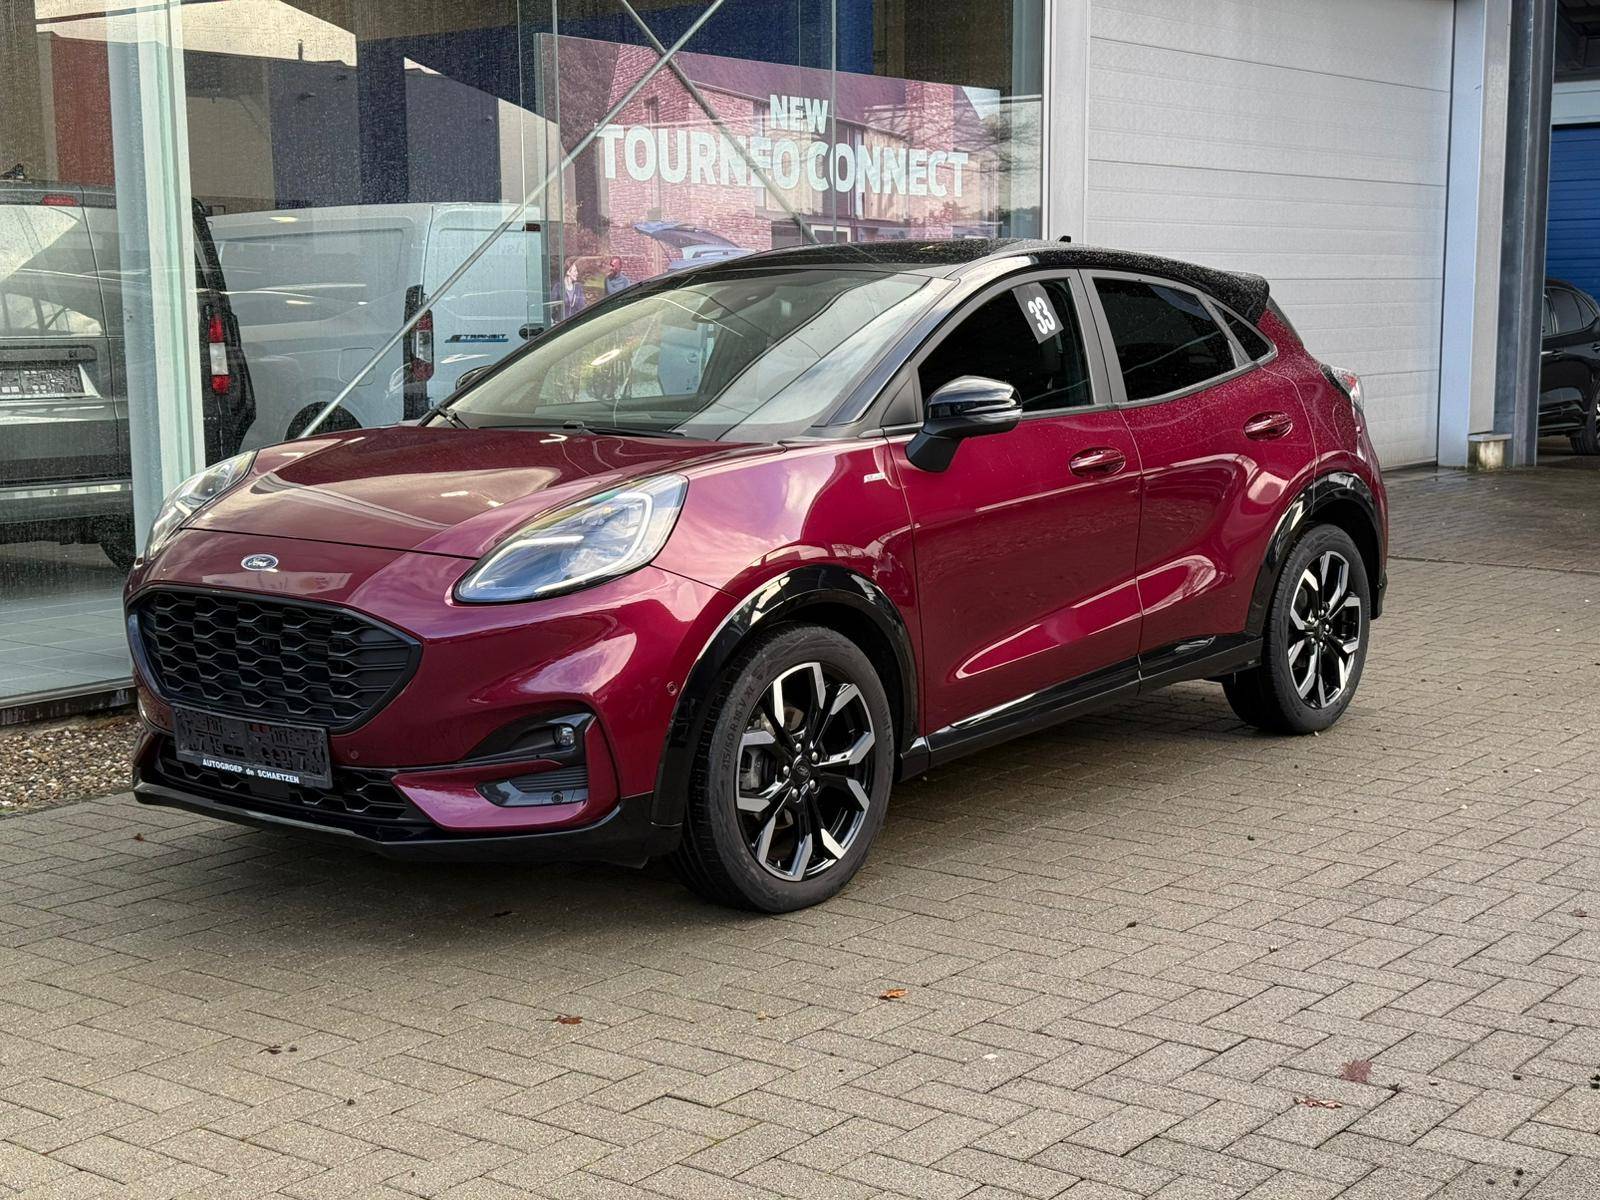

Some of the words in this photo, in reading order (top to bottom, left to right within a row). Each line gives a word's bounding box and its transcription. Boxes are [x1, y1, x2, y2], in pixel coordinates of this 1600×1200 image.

[769, 94, 829, 134] NEW
[595, 123, 800, 190] TOURNEO
[807, 141, 968, 198] CONNECT
[1027, 296, 1056, 335] 33
[202, 758, 243, 773] AUTOGROEP
[245, 768, 255, 776] de
[257, 769, 300, 784] SCHAETZEN
